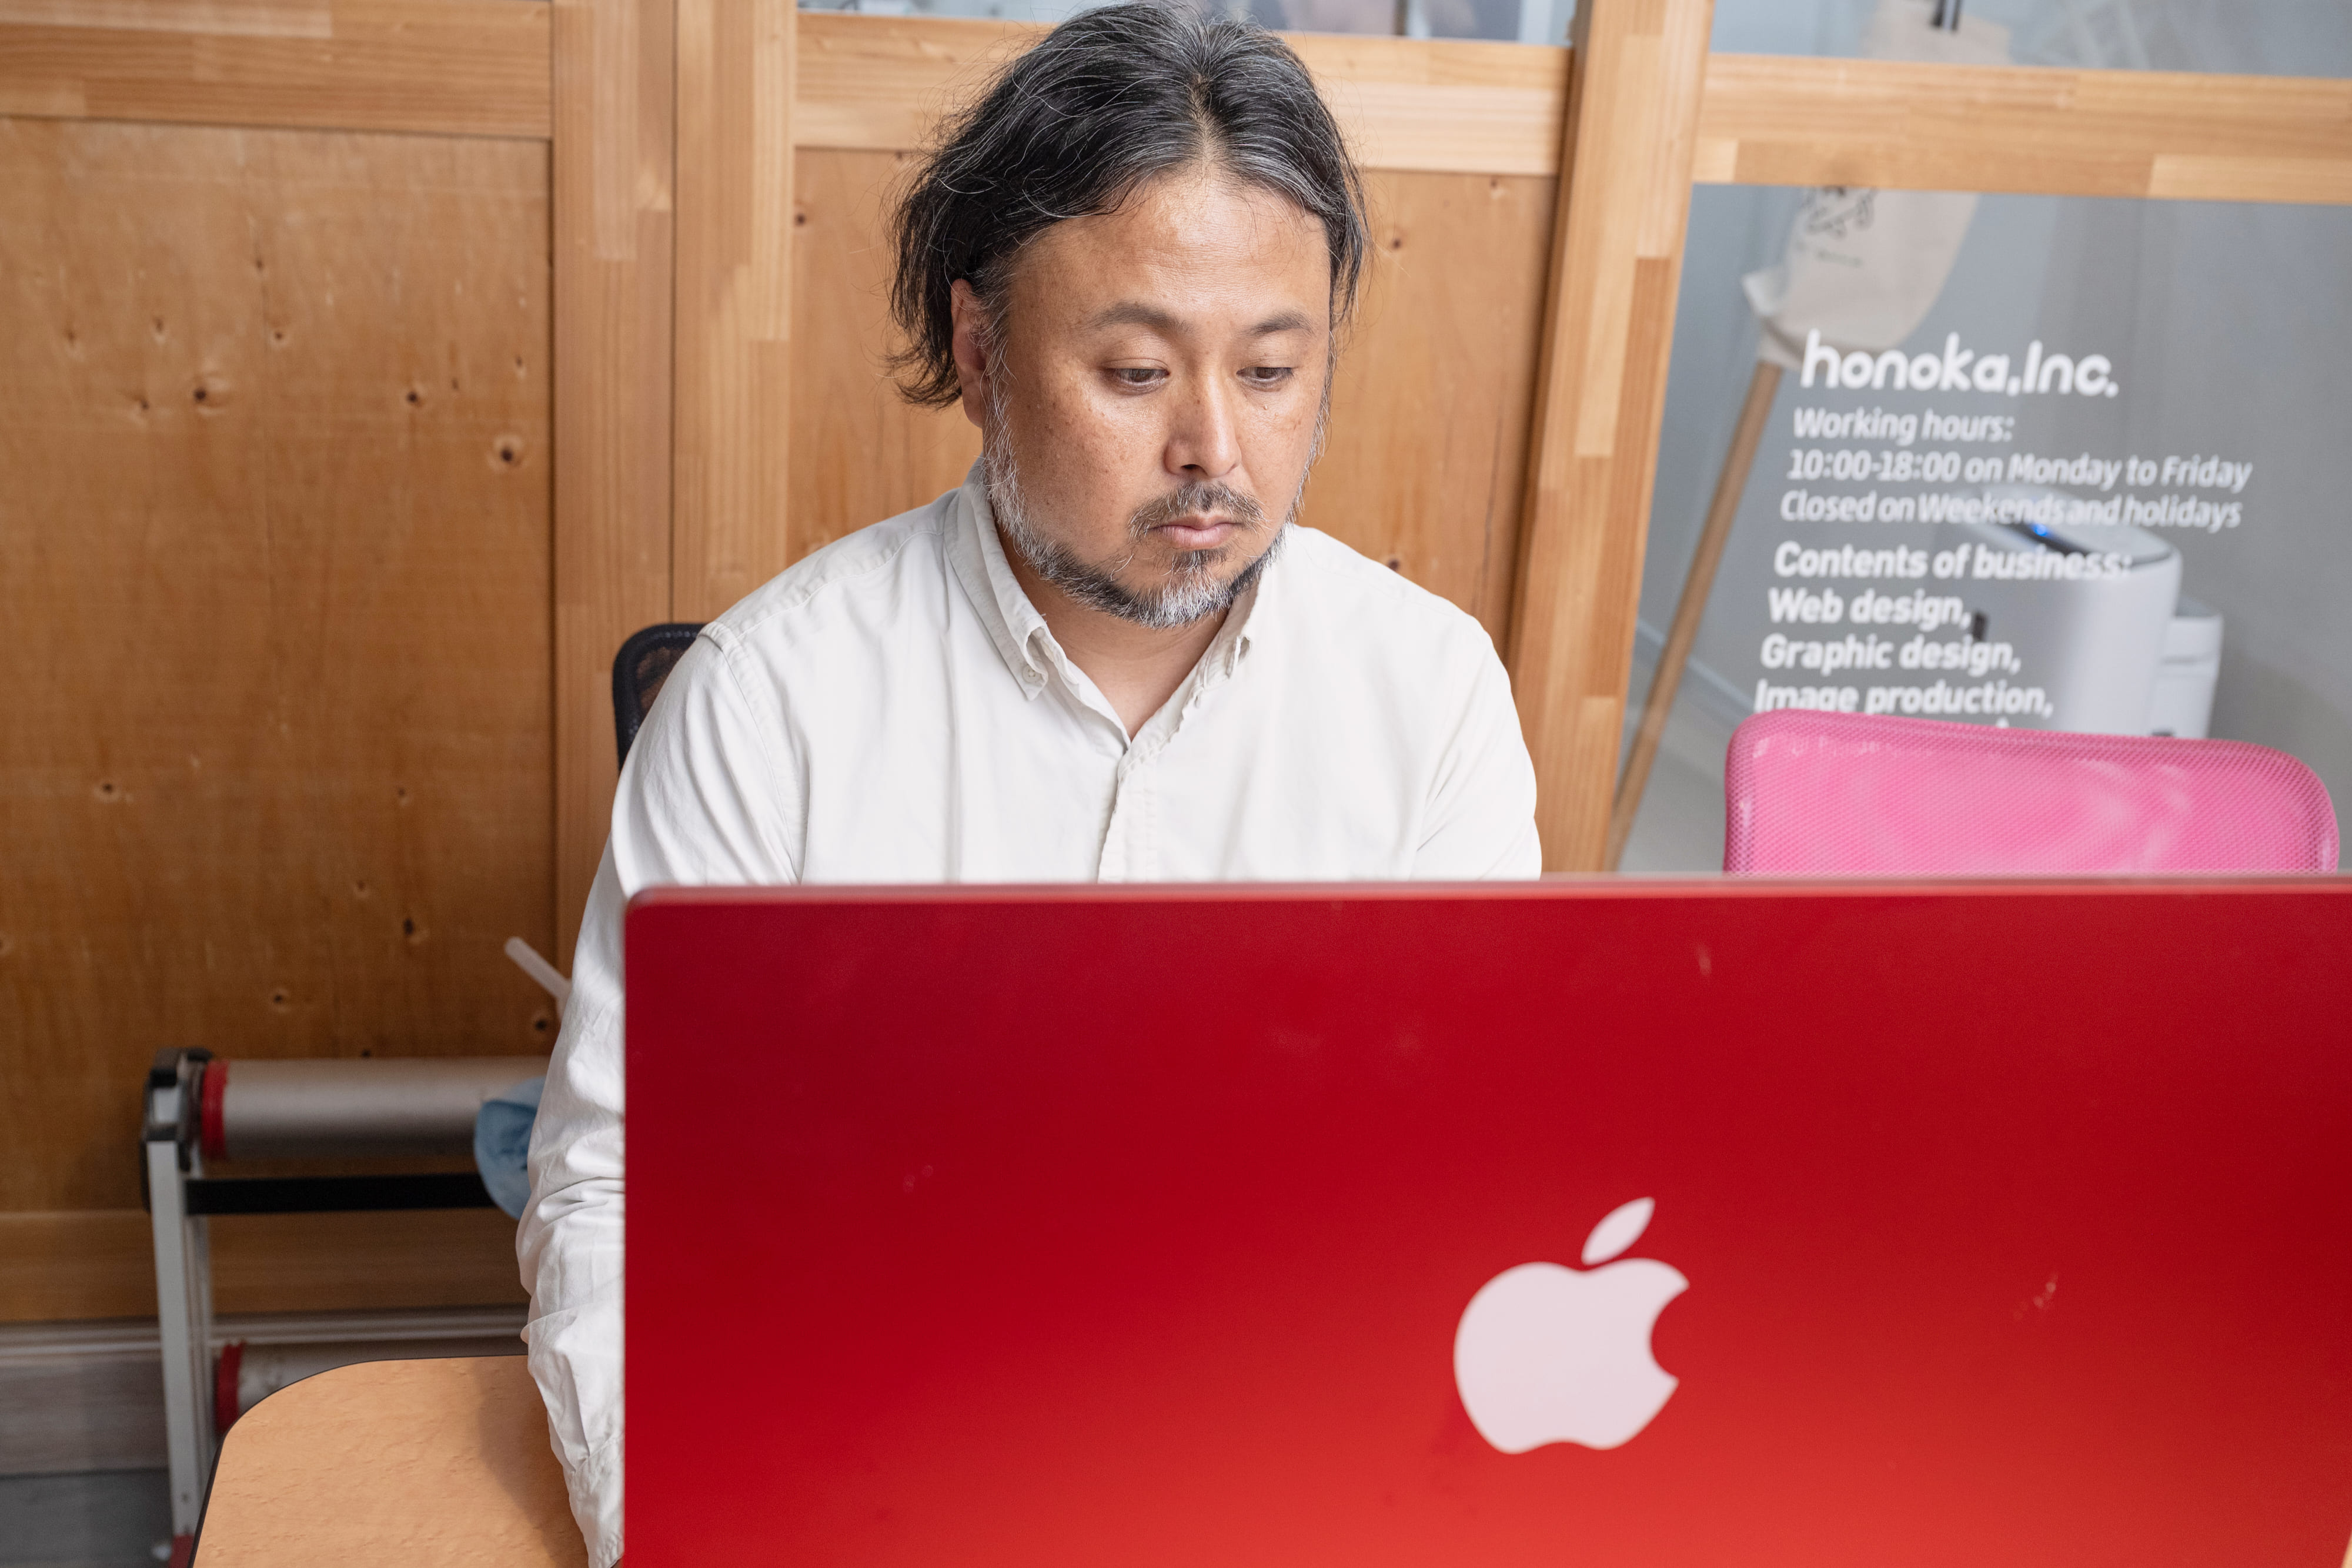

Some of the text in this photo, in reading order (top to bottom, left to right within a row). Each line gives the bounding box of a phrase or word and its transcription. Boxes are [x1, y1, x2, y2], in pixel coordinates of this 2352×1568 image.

[1793, 406, 2016, 446] Working hours:
[1786, 449, 2253, 493] 10:00-18:00 on Monday to Friday
[1780, 489, 2243, 534] Closed on Weekends and holidays
[1774, 541, 2133, 580] Contents of business:
[1768, 587, 1973, 633] Web design,
[1760, 633, 2022, 677] Graphic design,
[1755, 678, 2054, 719] Image production,
